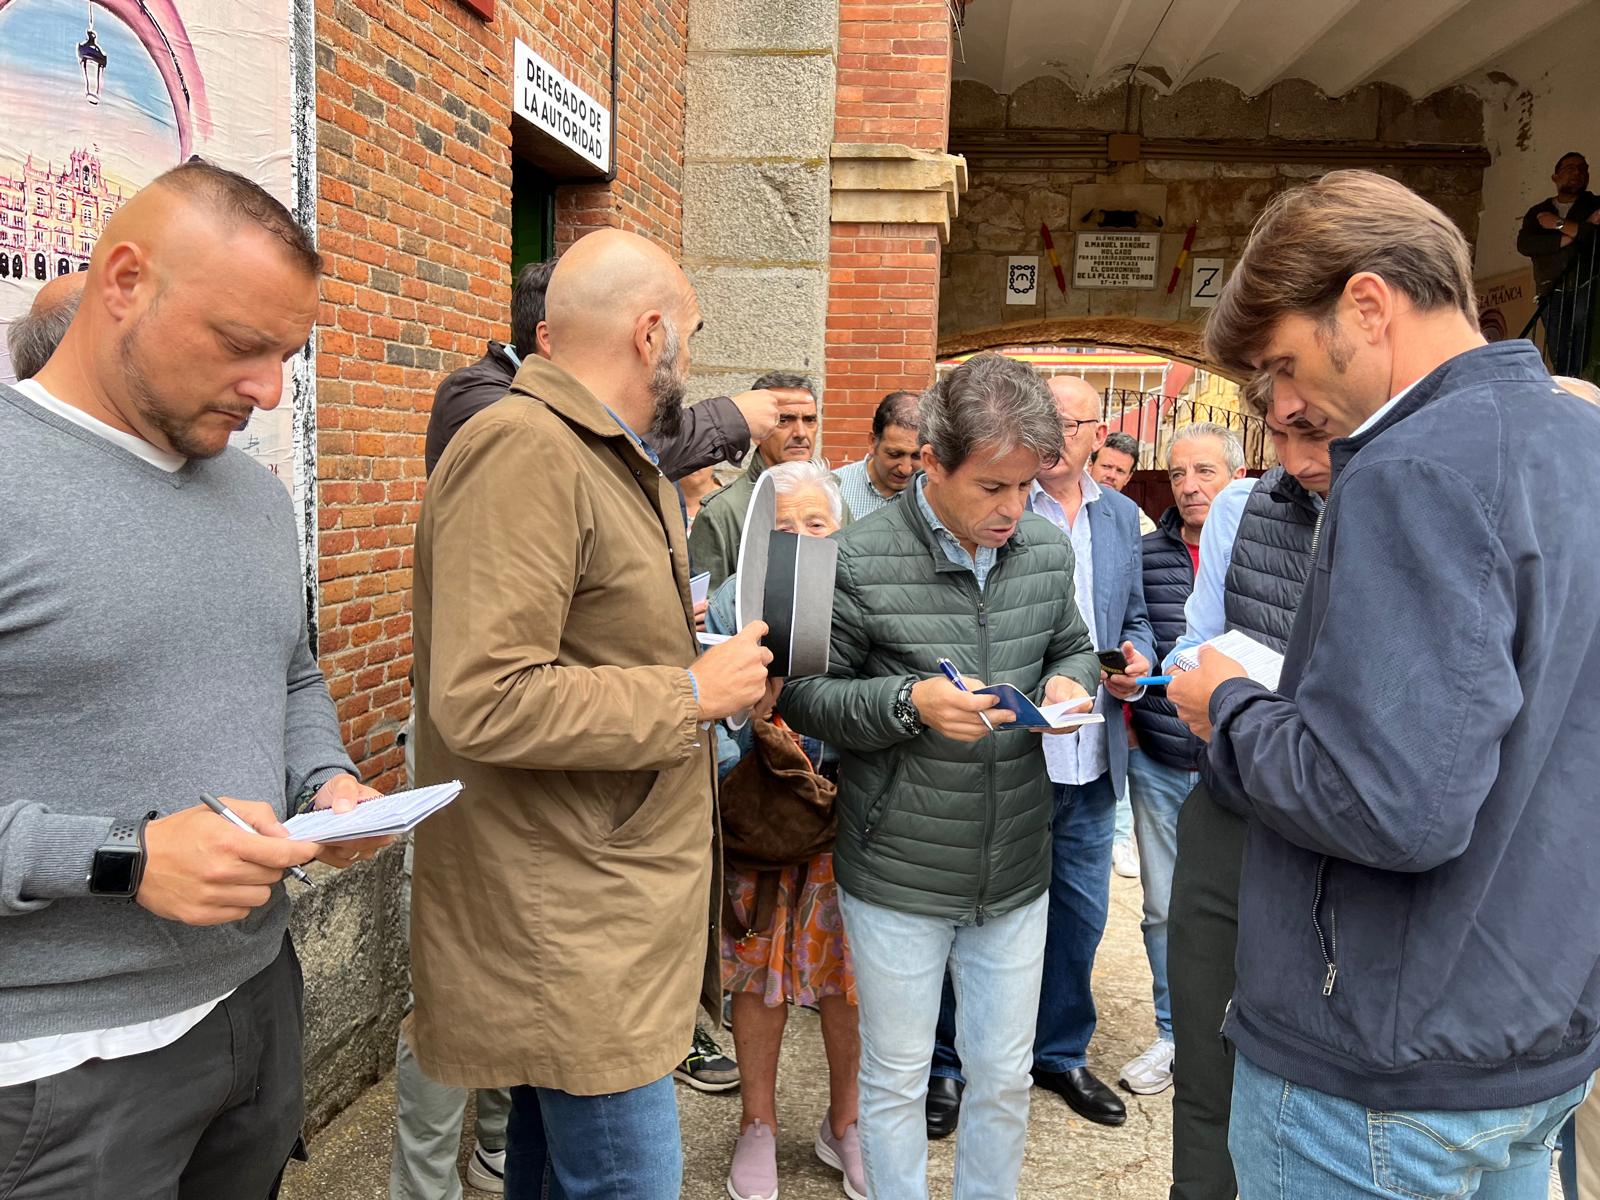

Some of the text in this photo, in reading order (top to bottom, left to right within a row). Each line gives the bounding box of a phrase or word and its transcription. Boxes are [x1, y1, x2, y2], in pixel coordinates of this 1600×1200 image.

[524, 87, 602, 160] LA AUTORIDAD
[527, 58, 601, 133] DELEGADO DE
